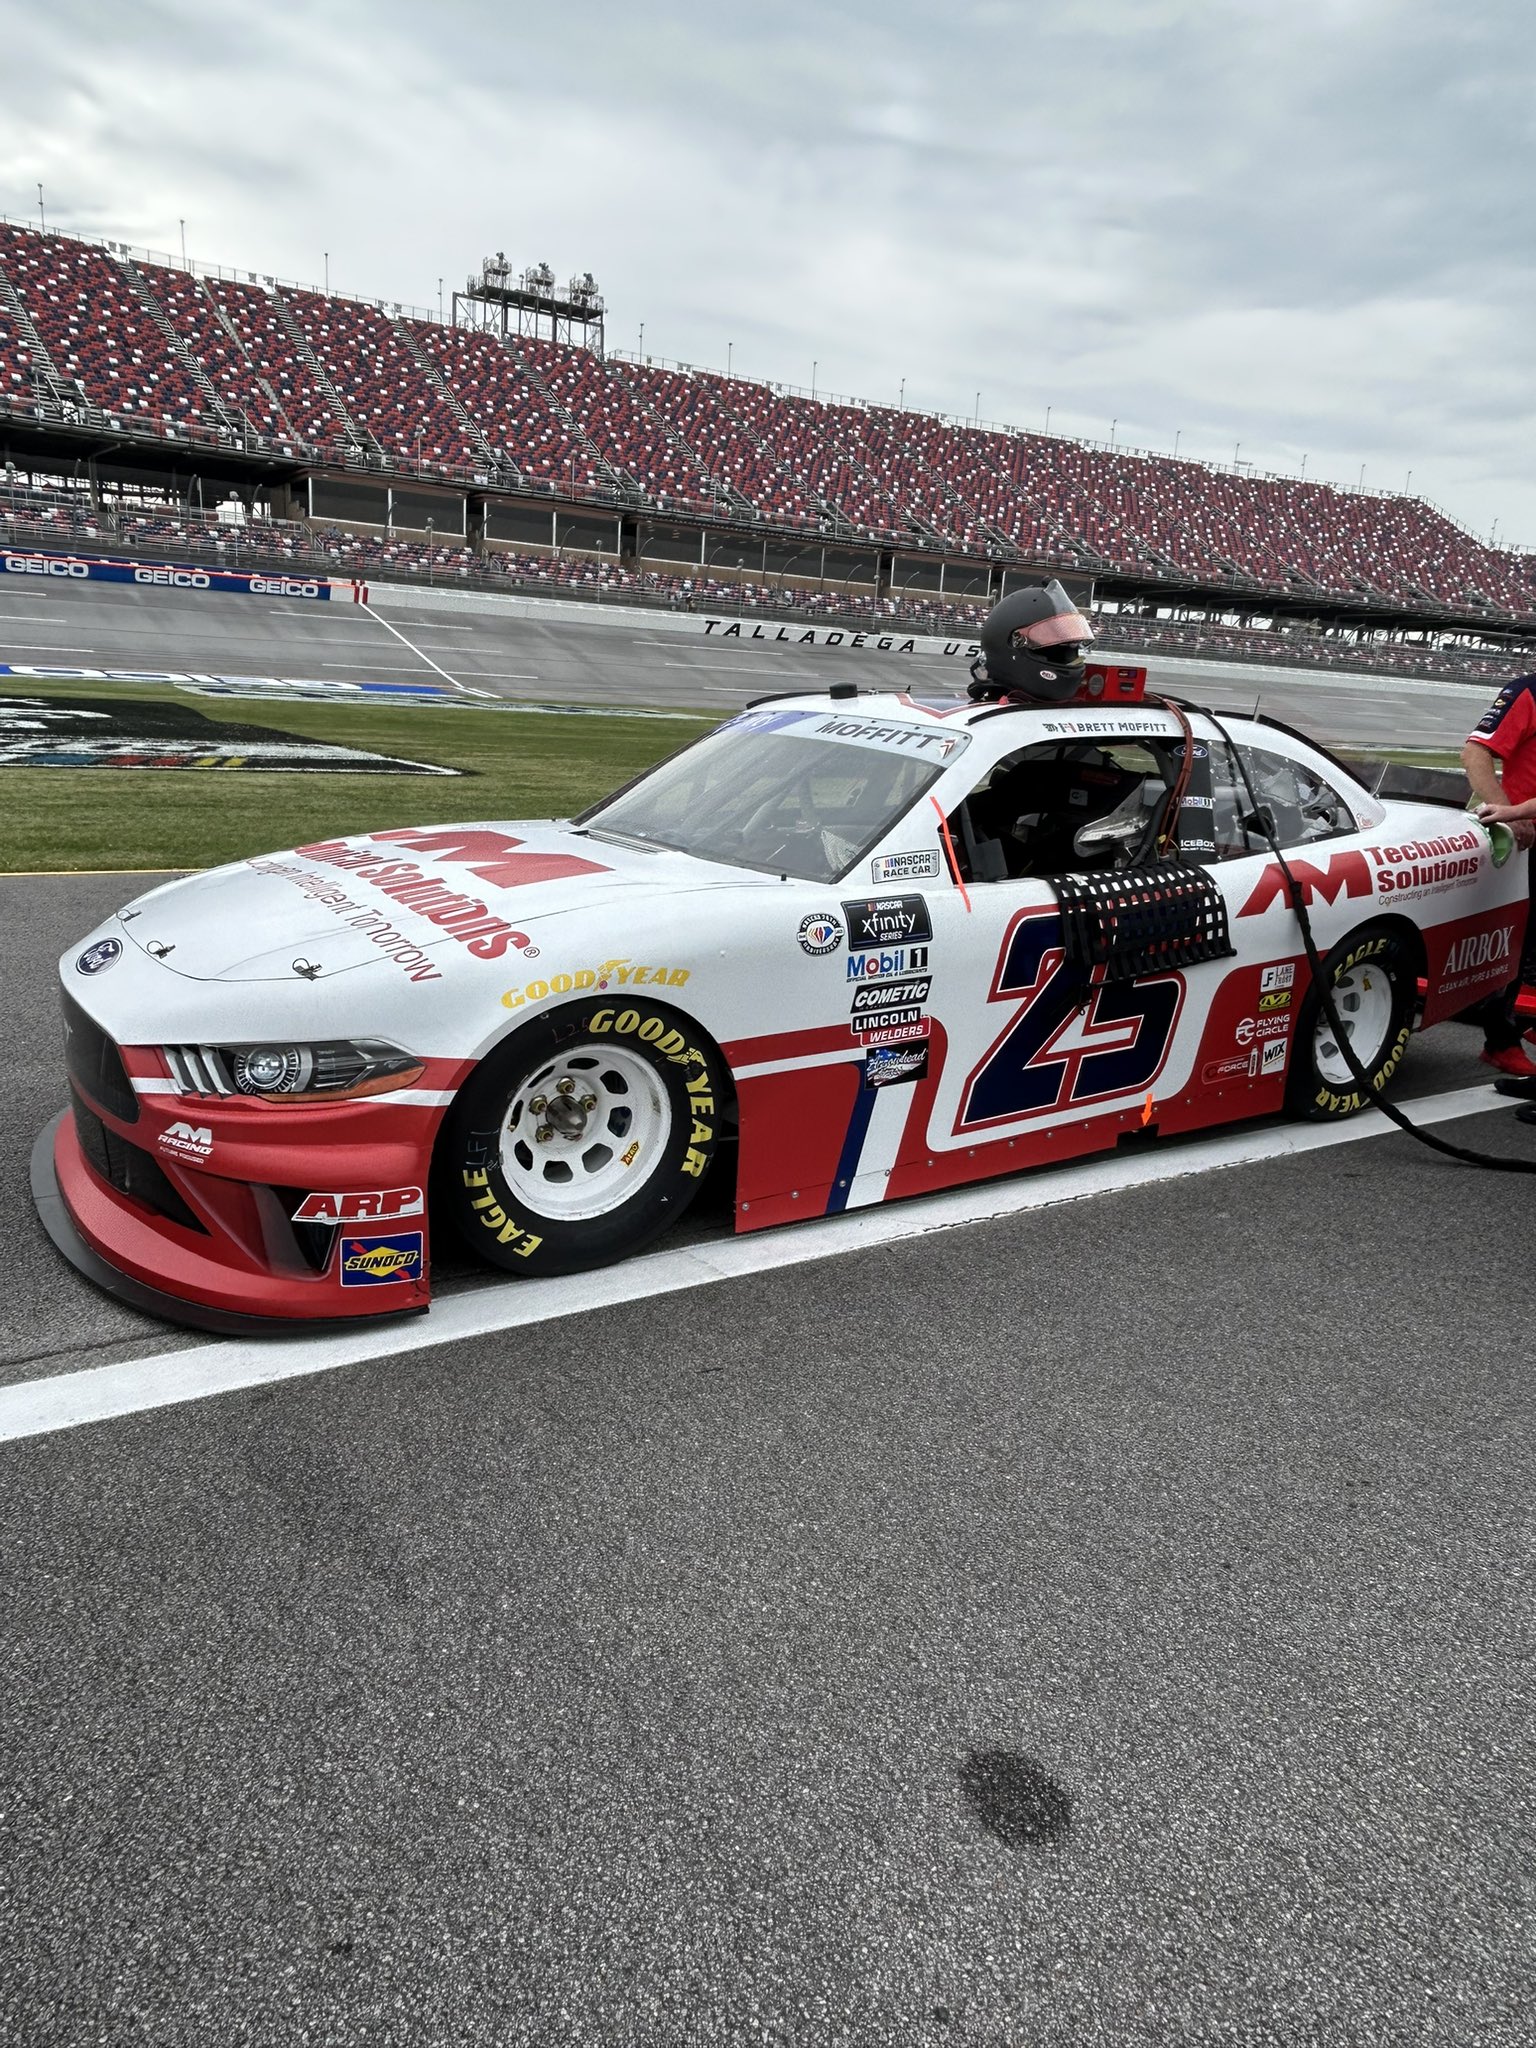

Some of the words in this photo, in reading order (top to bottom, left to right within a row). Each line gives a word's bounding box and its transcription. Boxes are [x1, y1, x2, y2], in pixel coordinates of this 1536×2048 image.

[5, 556, 90, 579] GEICO
[134, 568, 211, 589] GEICO
[249, 579, 319, 598] GEICO
[704, 620, 915, 653] TALLADEGA
[943, 642, 981, 657] US
[815, 721, 943, 749] MOFFITT
[1077, 722, 1115, 732] BRETT
[1118, 722, 1167, 732] MOFFITT
[894, 854, 931, 867] NASCAR
[1364, 831, 1479, 866] Technical
[883, 867, 909, 878] RACE
[912, 865, 931, 874] CAR
[1377, 856, 1479, 893] Solutions
[1235, 850, 1374, 918] AM
[876, 900, 904, 911] NASCAR
[1379, 889, 1422, 906] Constructing
[356, 863, 531, 960] Solutions
[862, 911, 916, 938] xfinity
[880, 931, 903, 941] SERIES
[1333, 938, 1388, 985] EAGLE
[1442, 925, 1515, 976] AIRBOX
[847, 949, 905, 977] Mobil
[501, 958, 691, 1009] GOODYEAR
[855, 982, 929, 1008] COMETIC
[951, 877, 1208, 1137] 25
[855, 1010, 918, 1031] LINCOLN
[1256, 1014, 1290, 1028] FLYING
[1256, 1024, 1289, 1038] CIRCLE
[869, 1025, 924, 1043] WELDERS
[1264, 1041, 1286, 1063] WIX
[588, 1008, 716, 1179] GOODYEAR
[158, 1134, 214, 1155] RACING
[164, 1121, 212, 1145] AM
[297, 1187, 422, 1218] ARP
[463, 1167, 544, 1258] EAGLE
[346, 1251, 417, 1271] SUNOCO
